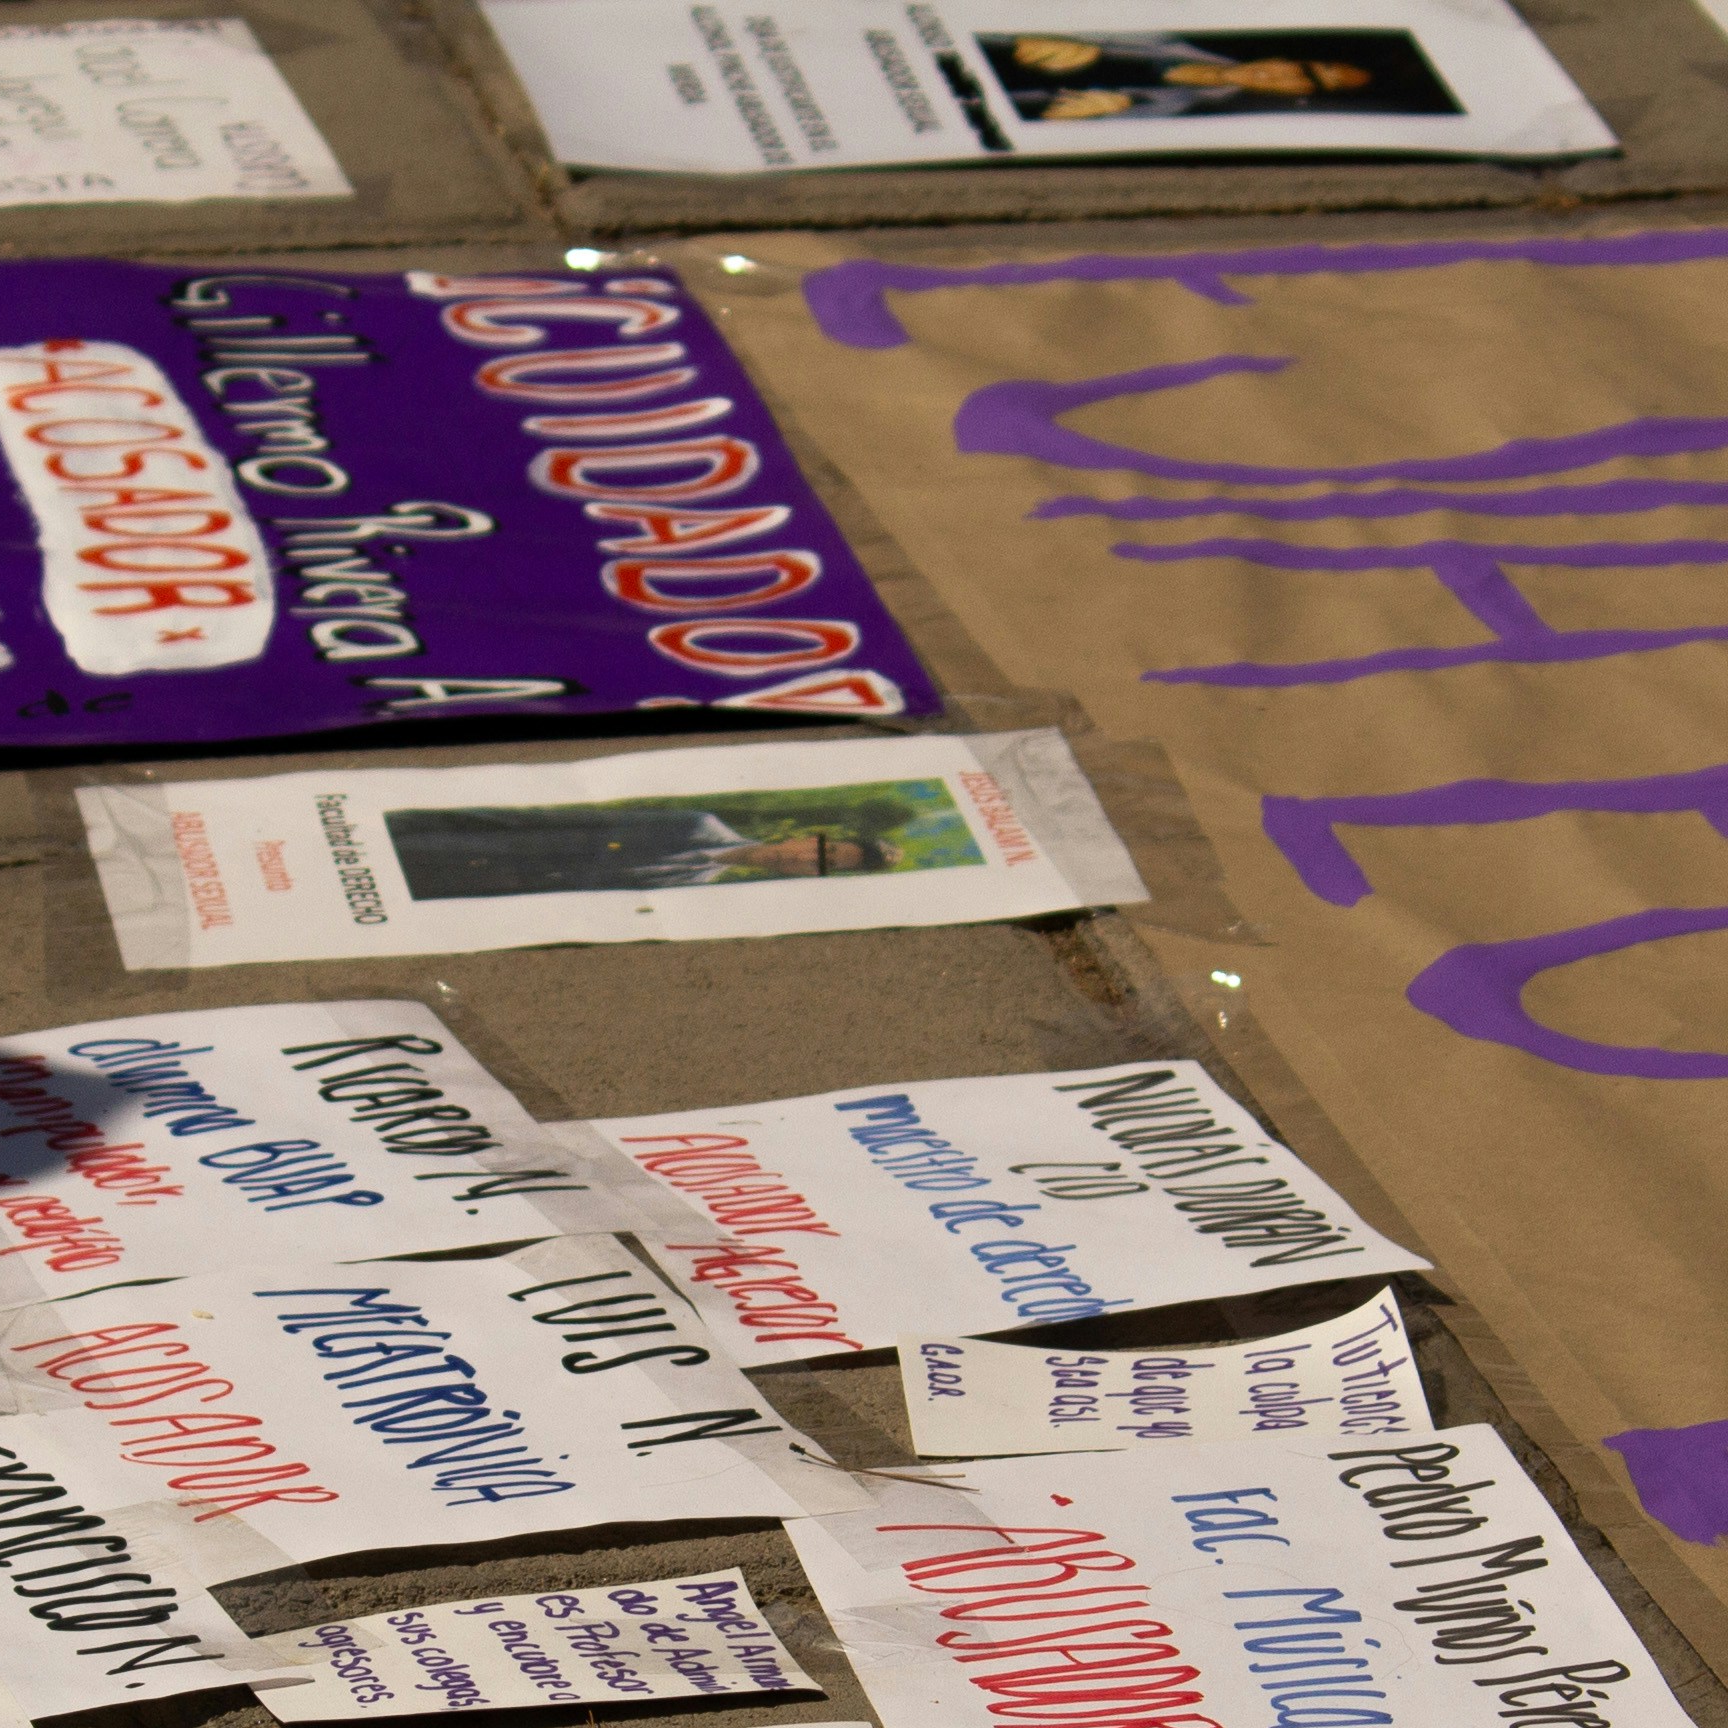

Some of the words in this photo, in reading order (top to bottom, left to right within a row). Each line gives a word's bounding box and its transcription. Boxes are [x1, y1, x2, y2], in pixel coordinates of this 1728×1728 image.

[341, 868, 393, 924] DERECHO
[928, 1200, 1041, 1234] de
[508, 1271, 710, 1374] LUIS
[1132, 1358, 1215, 1380] de
[1243, 1344, 1312, 1374] la
[14, 1323, 340, 1522] ACOSADOR
[1239, 1383, 1334, 1431] culpa
[1326, 1443, 1496, 1540] Pedro
[387, 1612, 437, 1645] sus
[454, 1602, 506, 1615] y
[535, 1595, 585, 1618] es
[676, 1581, 771, 1639] Angel
[555, 1621, 654, 1694] Profesor
